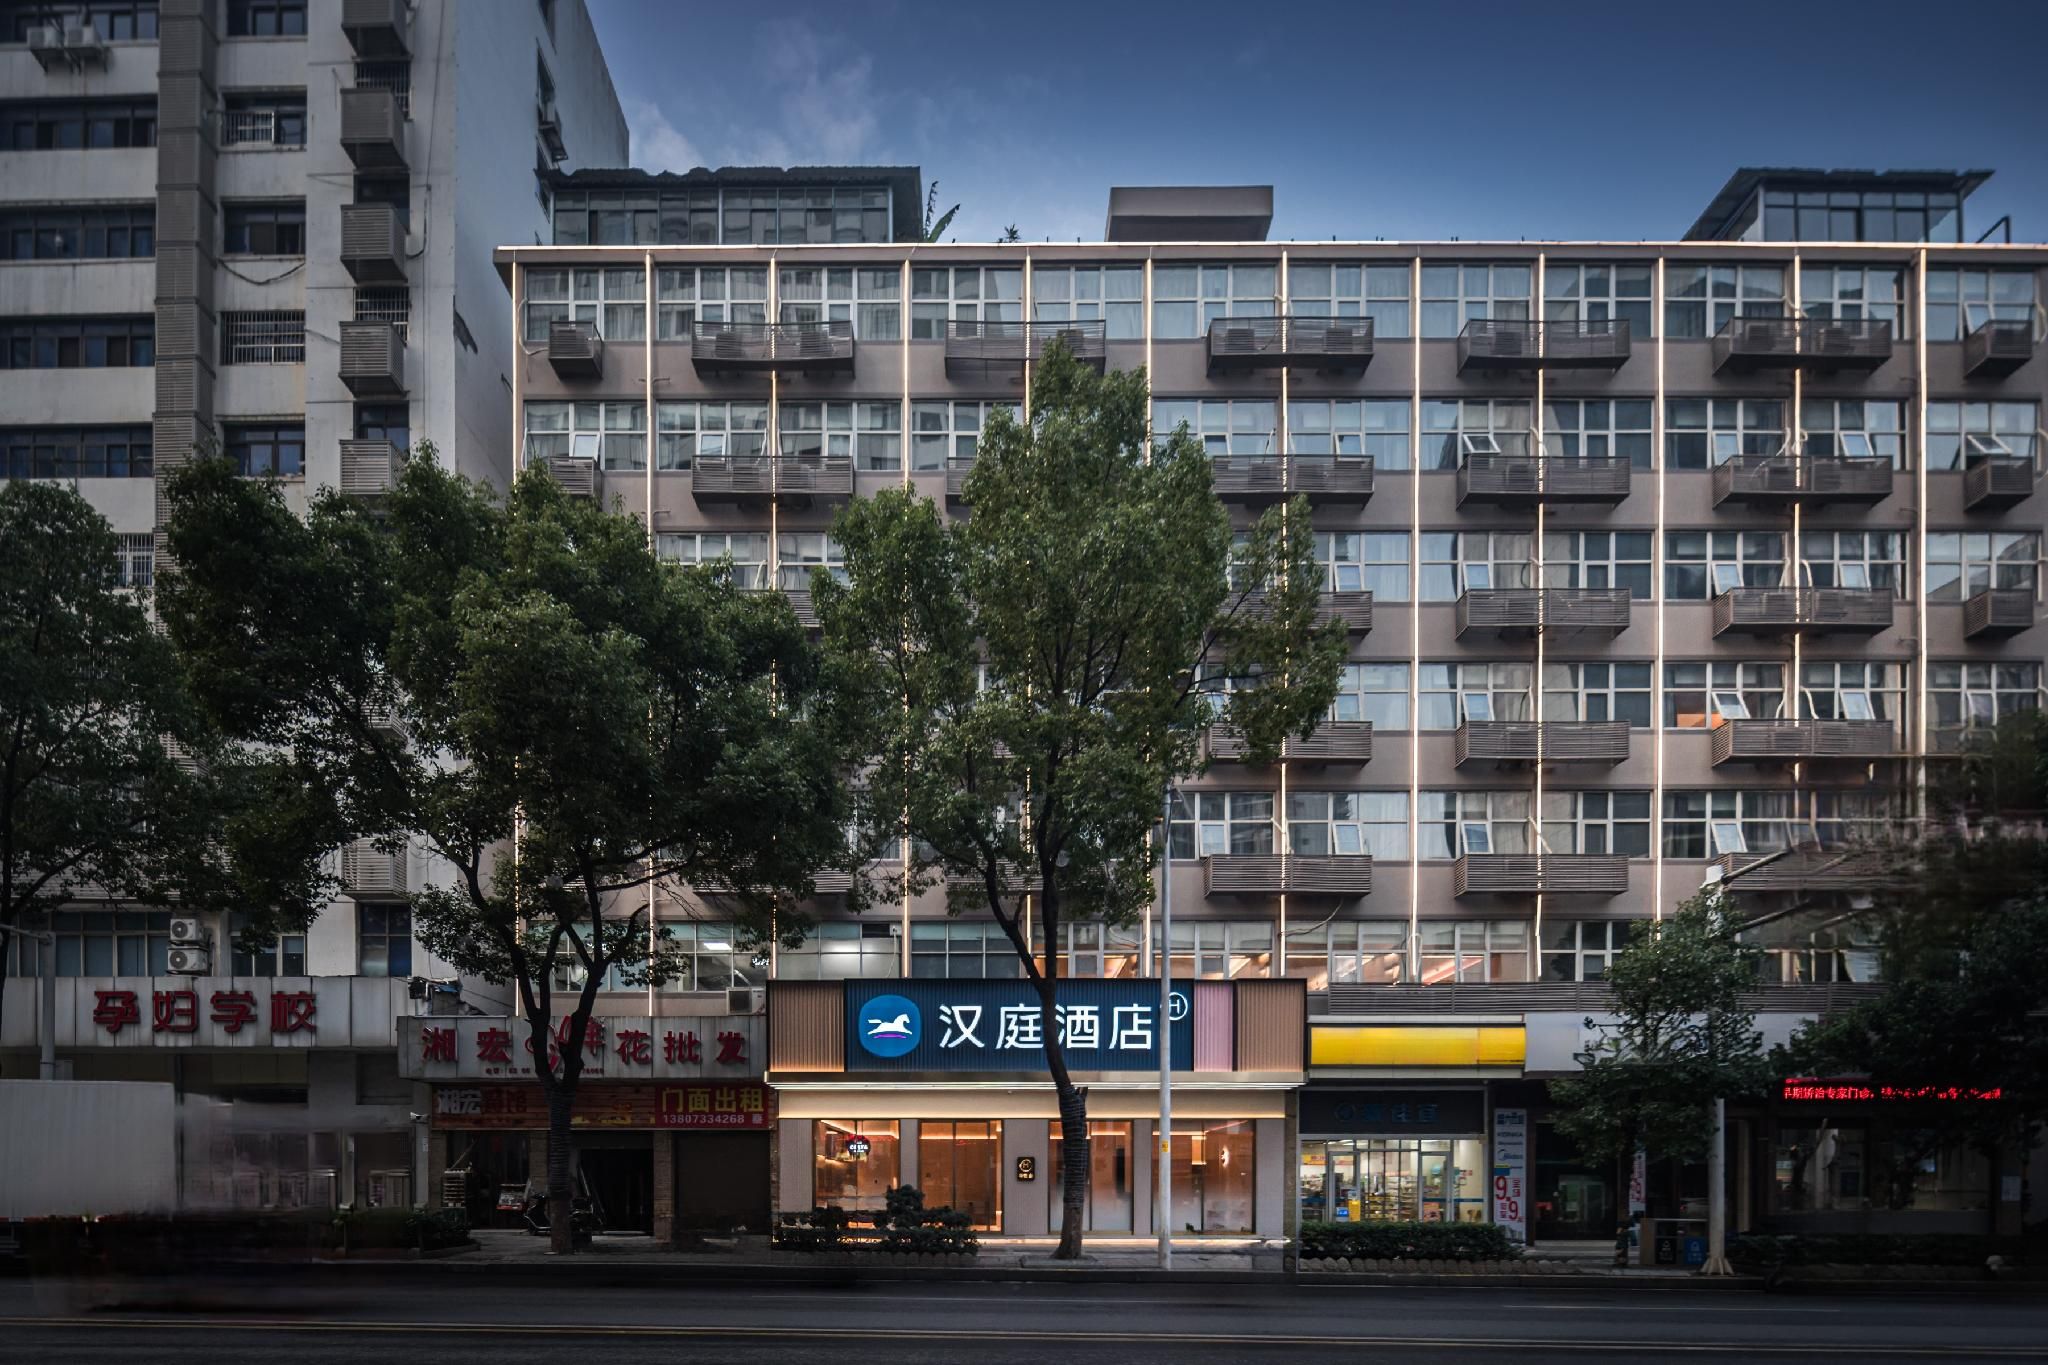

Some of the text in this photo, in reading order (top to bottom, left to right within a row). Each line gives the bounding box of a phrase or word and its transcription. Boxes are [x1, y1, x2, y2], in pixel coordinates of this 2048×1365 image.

[93, 990, 317, 1033] 孕妇学校
[938, 1003, 1153, 1050] 汉庭酒店
[661, 1087, 764, 1113] 门面出租
[663, 1114, 745, 1124] 13807334268
